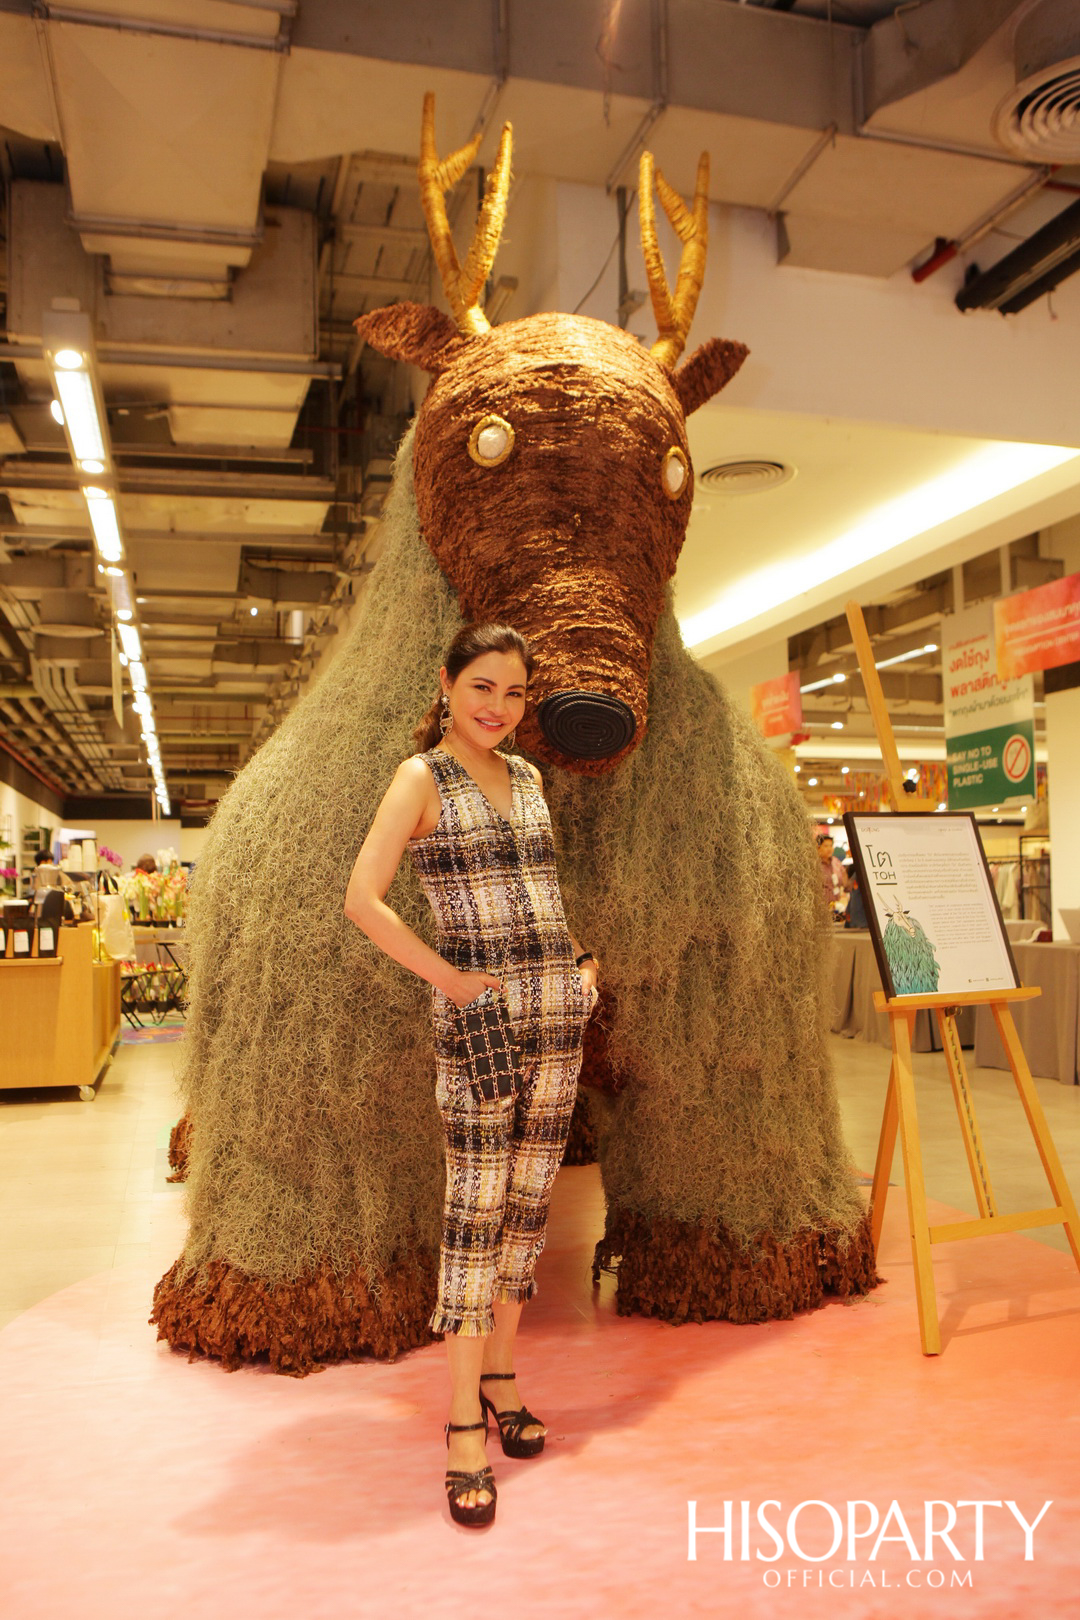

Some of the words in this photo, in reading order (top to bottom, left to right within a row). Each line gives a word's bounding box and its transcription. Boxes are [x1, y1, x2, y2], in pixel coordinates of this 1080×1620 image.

[967, 747, 980, 761] NO
[980, 745, 992, 757] TO
[952, 757, 998, 775] SINGLE-USE
[953, 773, 984, 788] PLASTIC
[865, 844, 893, 868] โต
[873, 871, 897, 881] TOH
